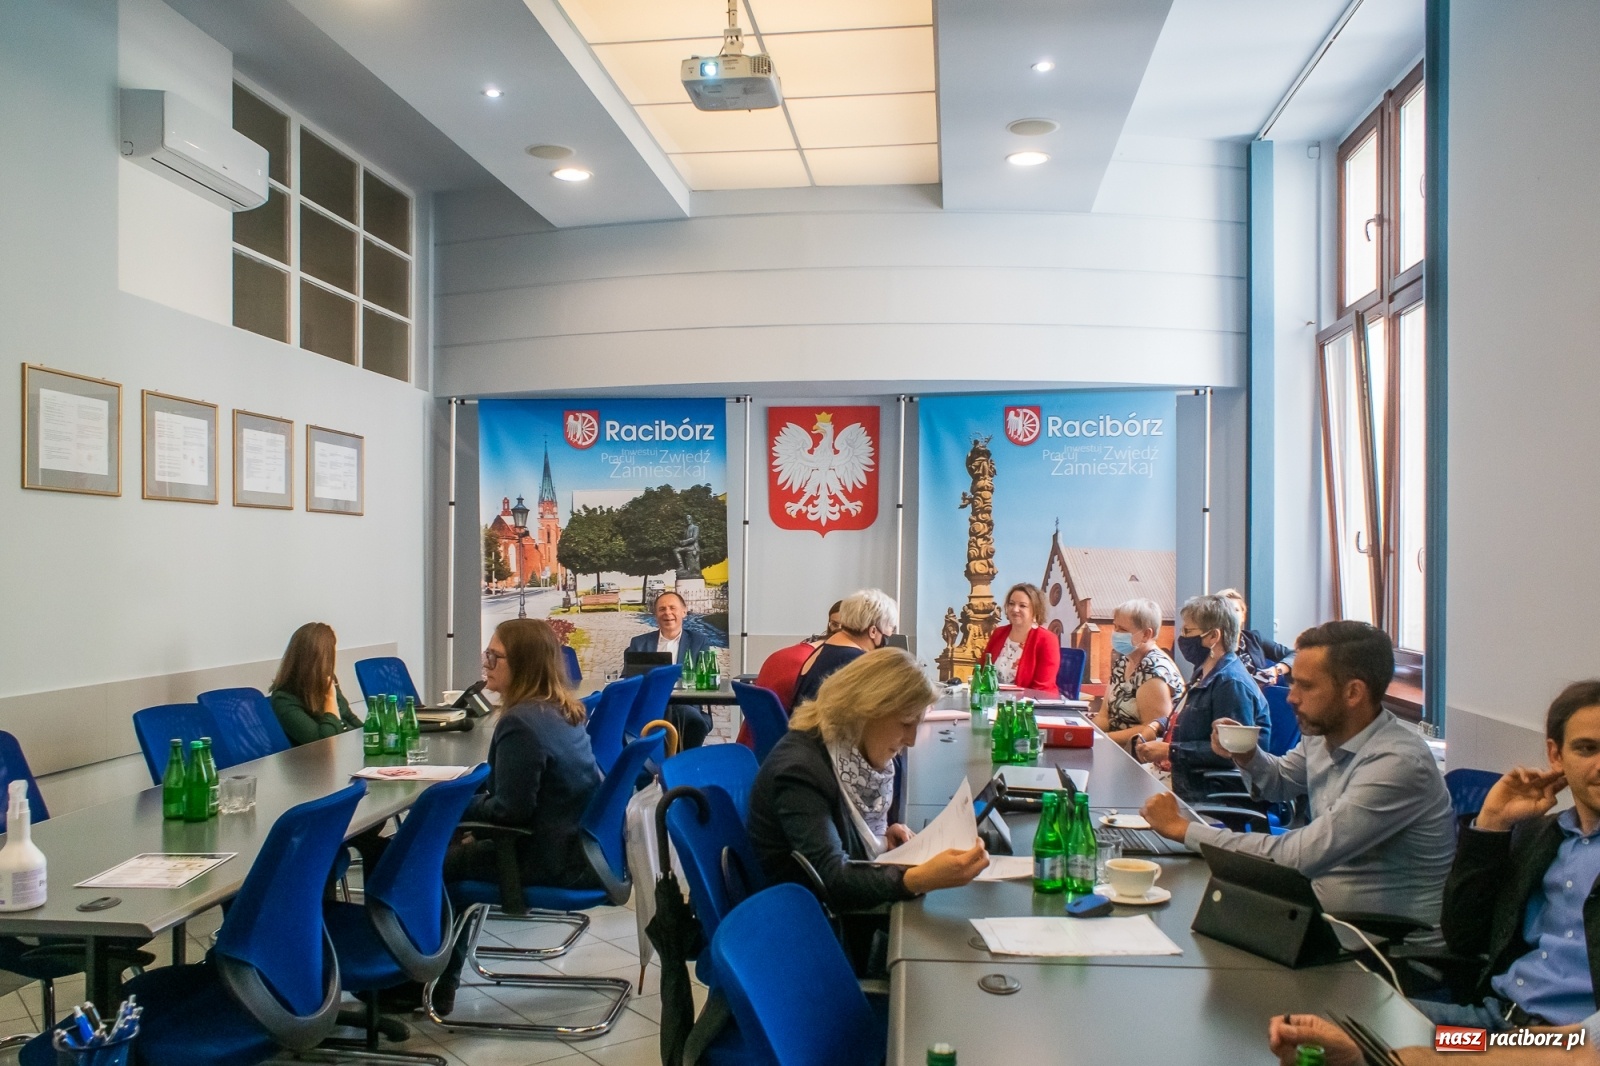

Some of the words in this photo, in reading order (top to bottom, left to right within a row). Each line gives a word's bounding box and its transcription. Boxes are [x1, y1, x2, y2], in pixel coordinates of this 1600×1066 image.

[605, 417, 715, 441] Racibórz
[1047, 412, 1164, 437] Racibórz
[609, 460, 707, 480] Zamieszkaj
[1050, 457, 1154, 479] Zamieszkaj
